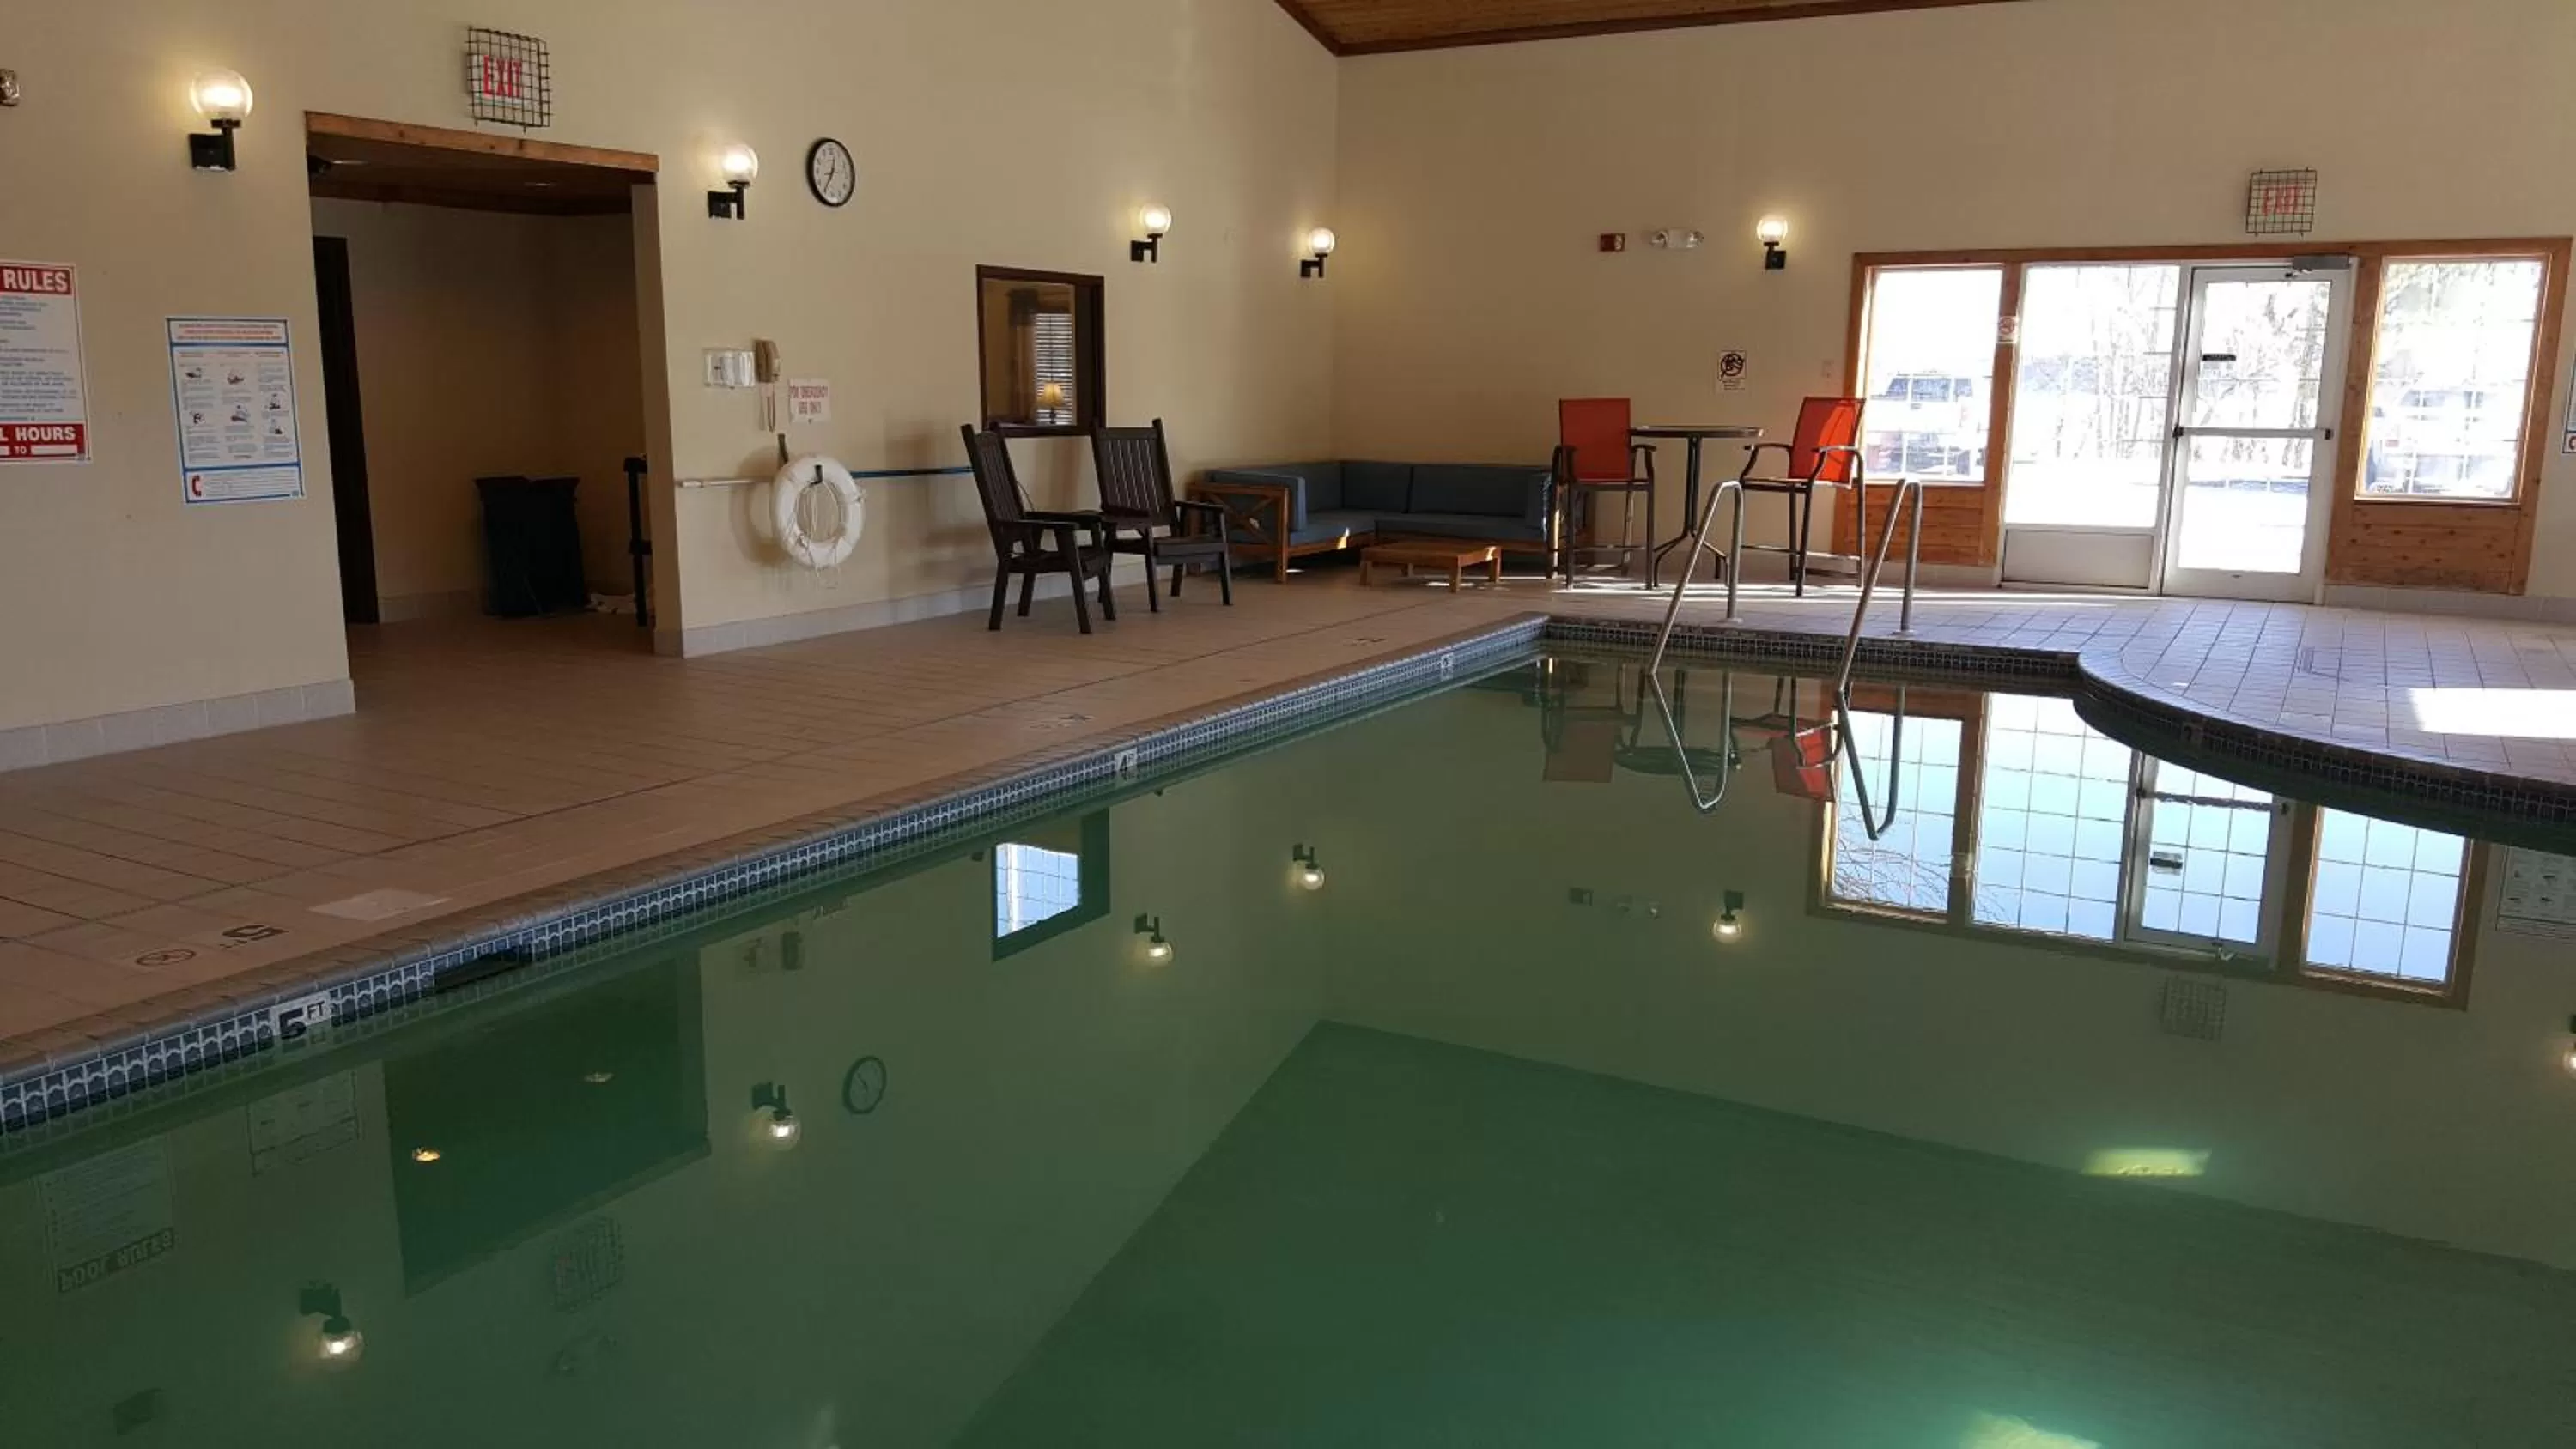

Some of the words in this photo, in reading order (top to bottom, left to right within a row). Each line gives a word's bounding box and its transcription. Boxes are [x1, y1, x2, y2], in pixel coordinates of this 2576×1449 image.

[483, 55, 523, 98] EXIT
[3, 269, 68, 292] RULES
[15, 426, 76, 442] HOURS
[14, 446, 27, 454] TO
[278, 1008, 307, 1040] 5
[307, 1000, 325, 1020] FT
